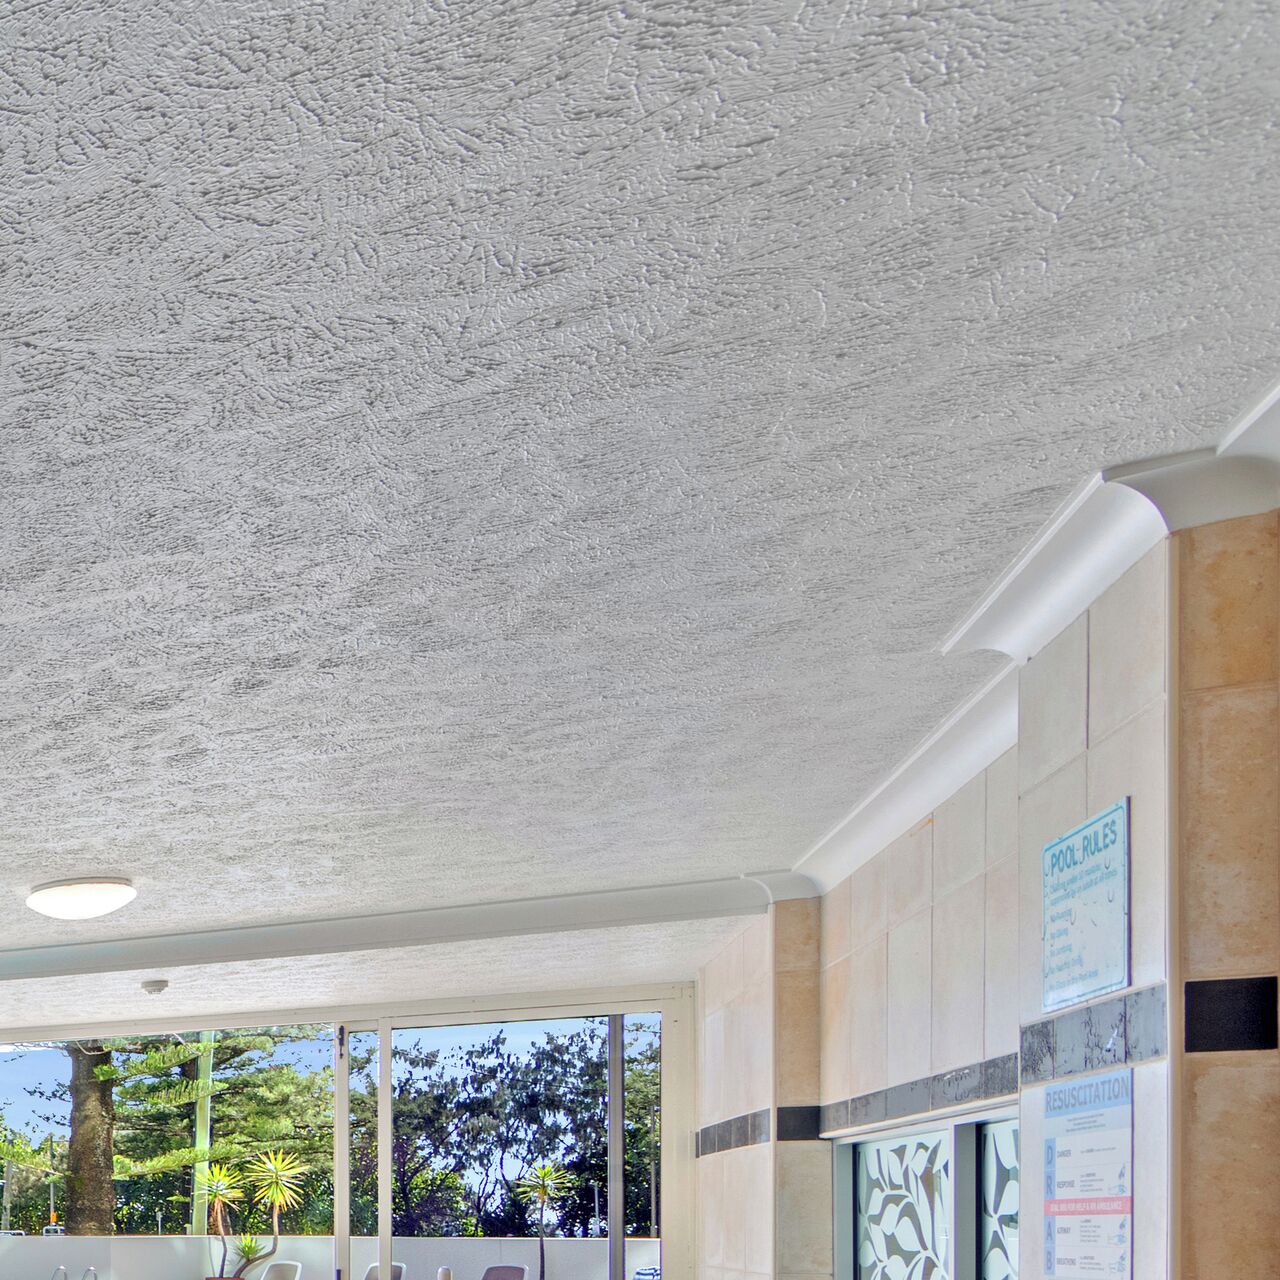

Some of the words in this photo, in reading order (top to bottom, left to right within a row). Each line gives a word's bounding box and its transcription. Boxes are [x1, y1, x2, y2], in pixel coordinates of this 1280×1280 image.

[1051, 843, 1078, 877] POOL
[1082, 819, 1117, 858] RULES
[1046, 1076, 1129, 1112] RESUSCITATION
